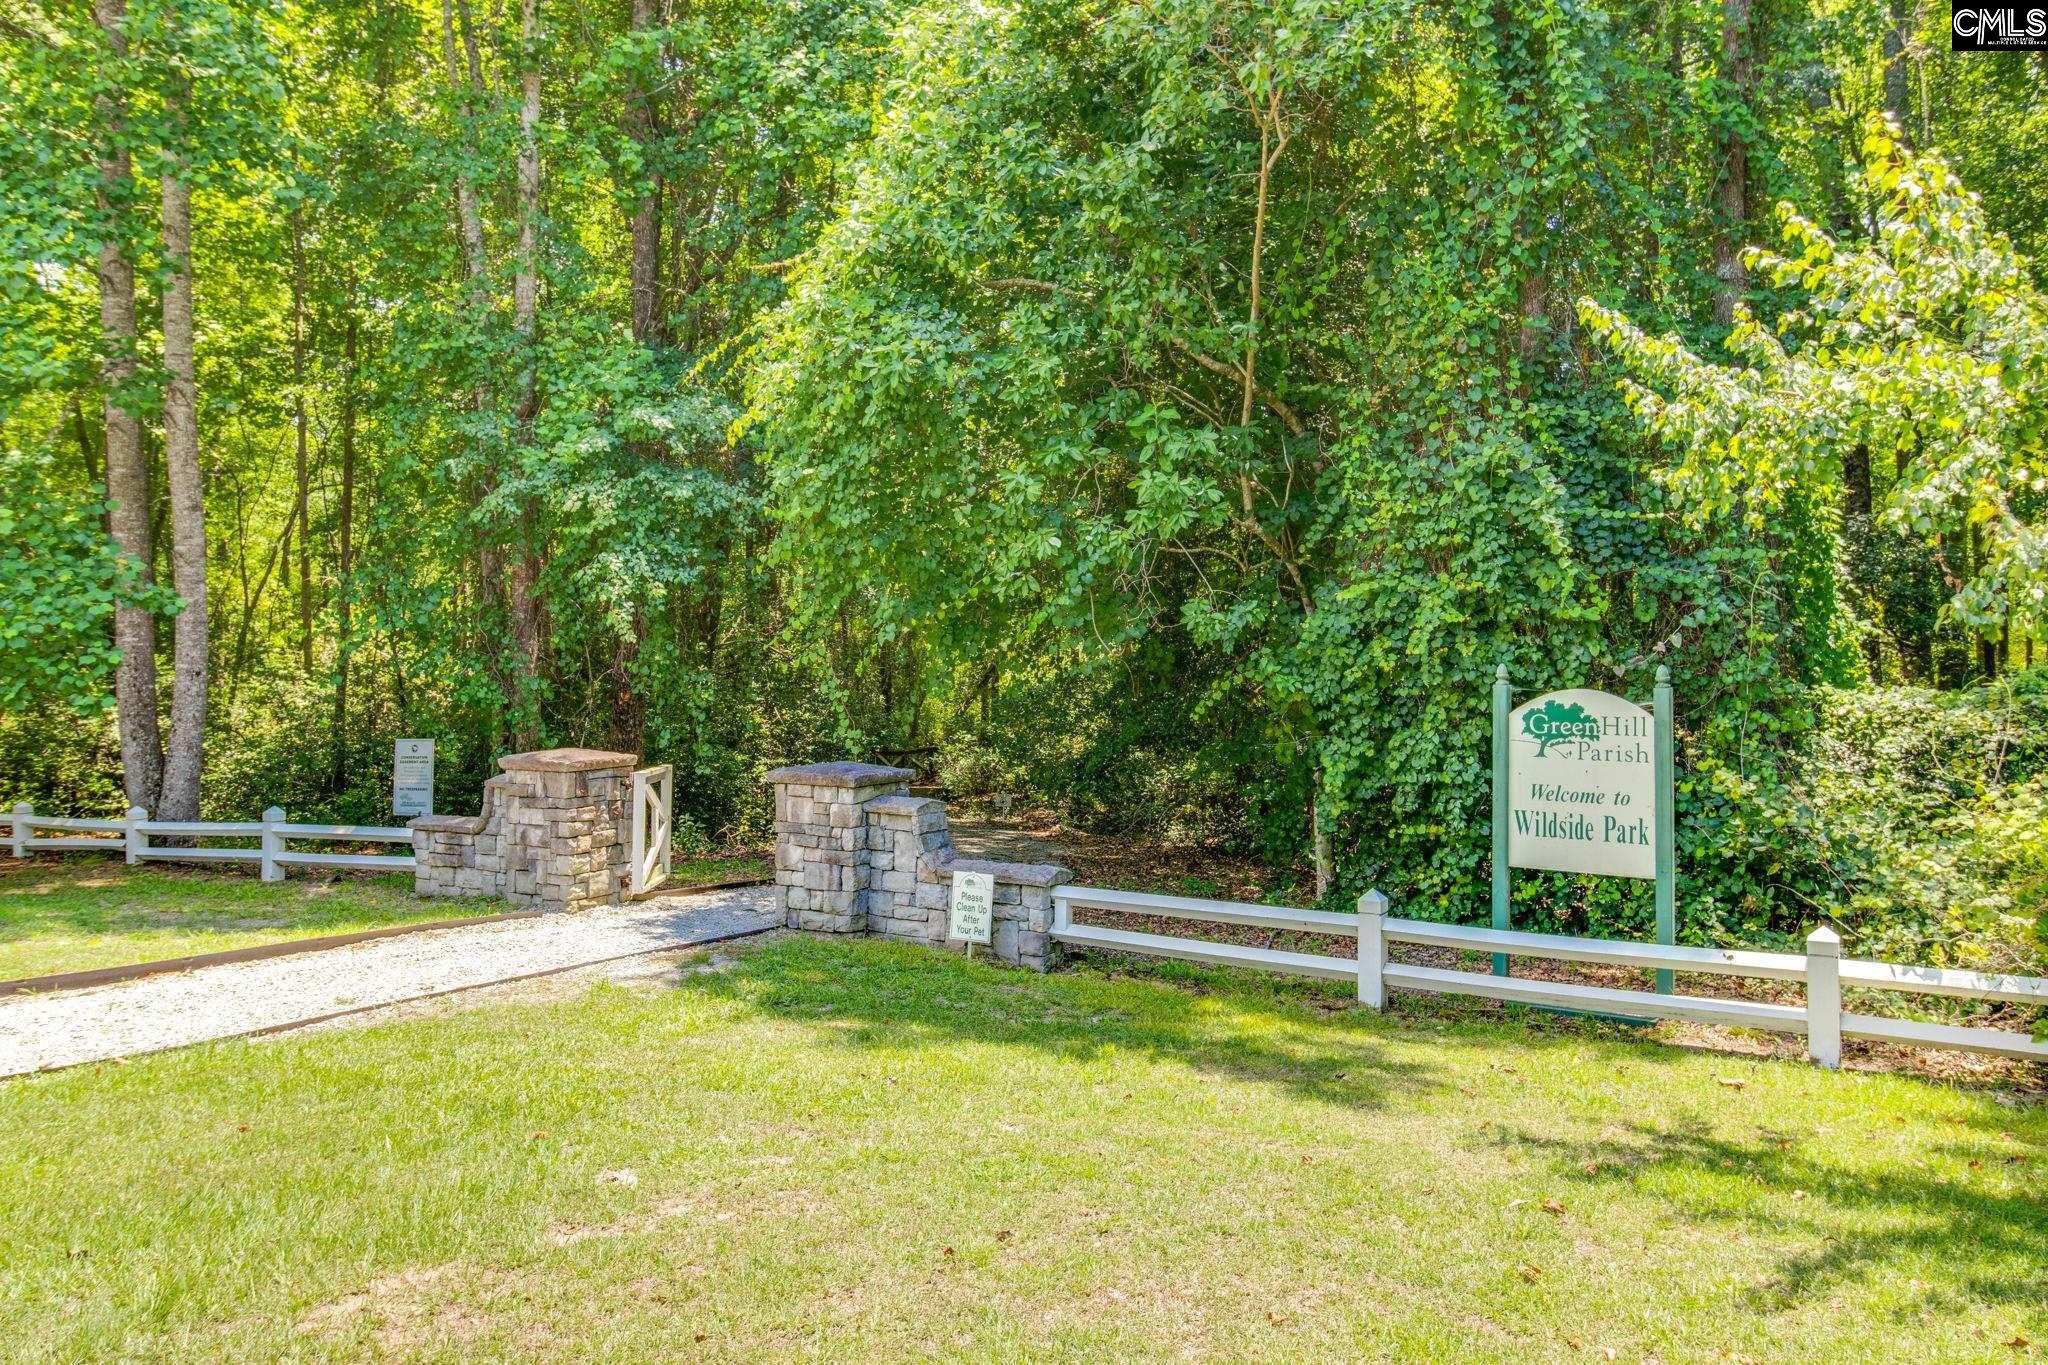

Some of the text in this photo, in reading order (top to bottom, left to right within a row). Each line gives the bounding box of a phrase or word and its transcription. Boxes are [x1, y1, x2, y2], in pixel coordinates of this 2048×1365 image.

[1577, 741, 1650, 764] Parish
[1530, 783, 1631, 806] Welcome to
[1514, 809, 1650, 846] Wildside Park
[961, 891, 984, 903] Please
[956, 901, 988, 915] Clean Up
[962, 914, 980, 924] After
[956, 924, 985, 936] Your Pet
